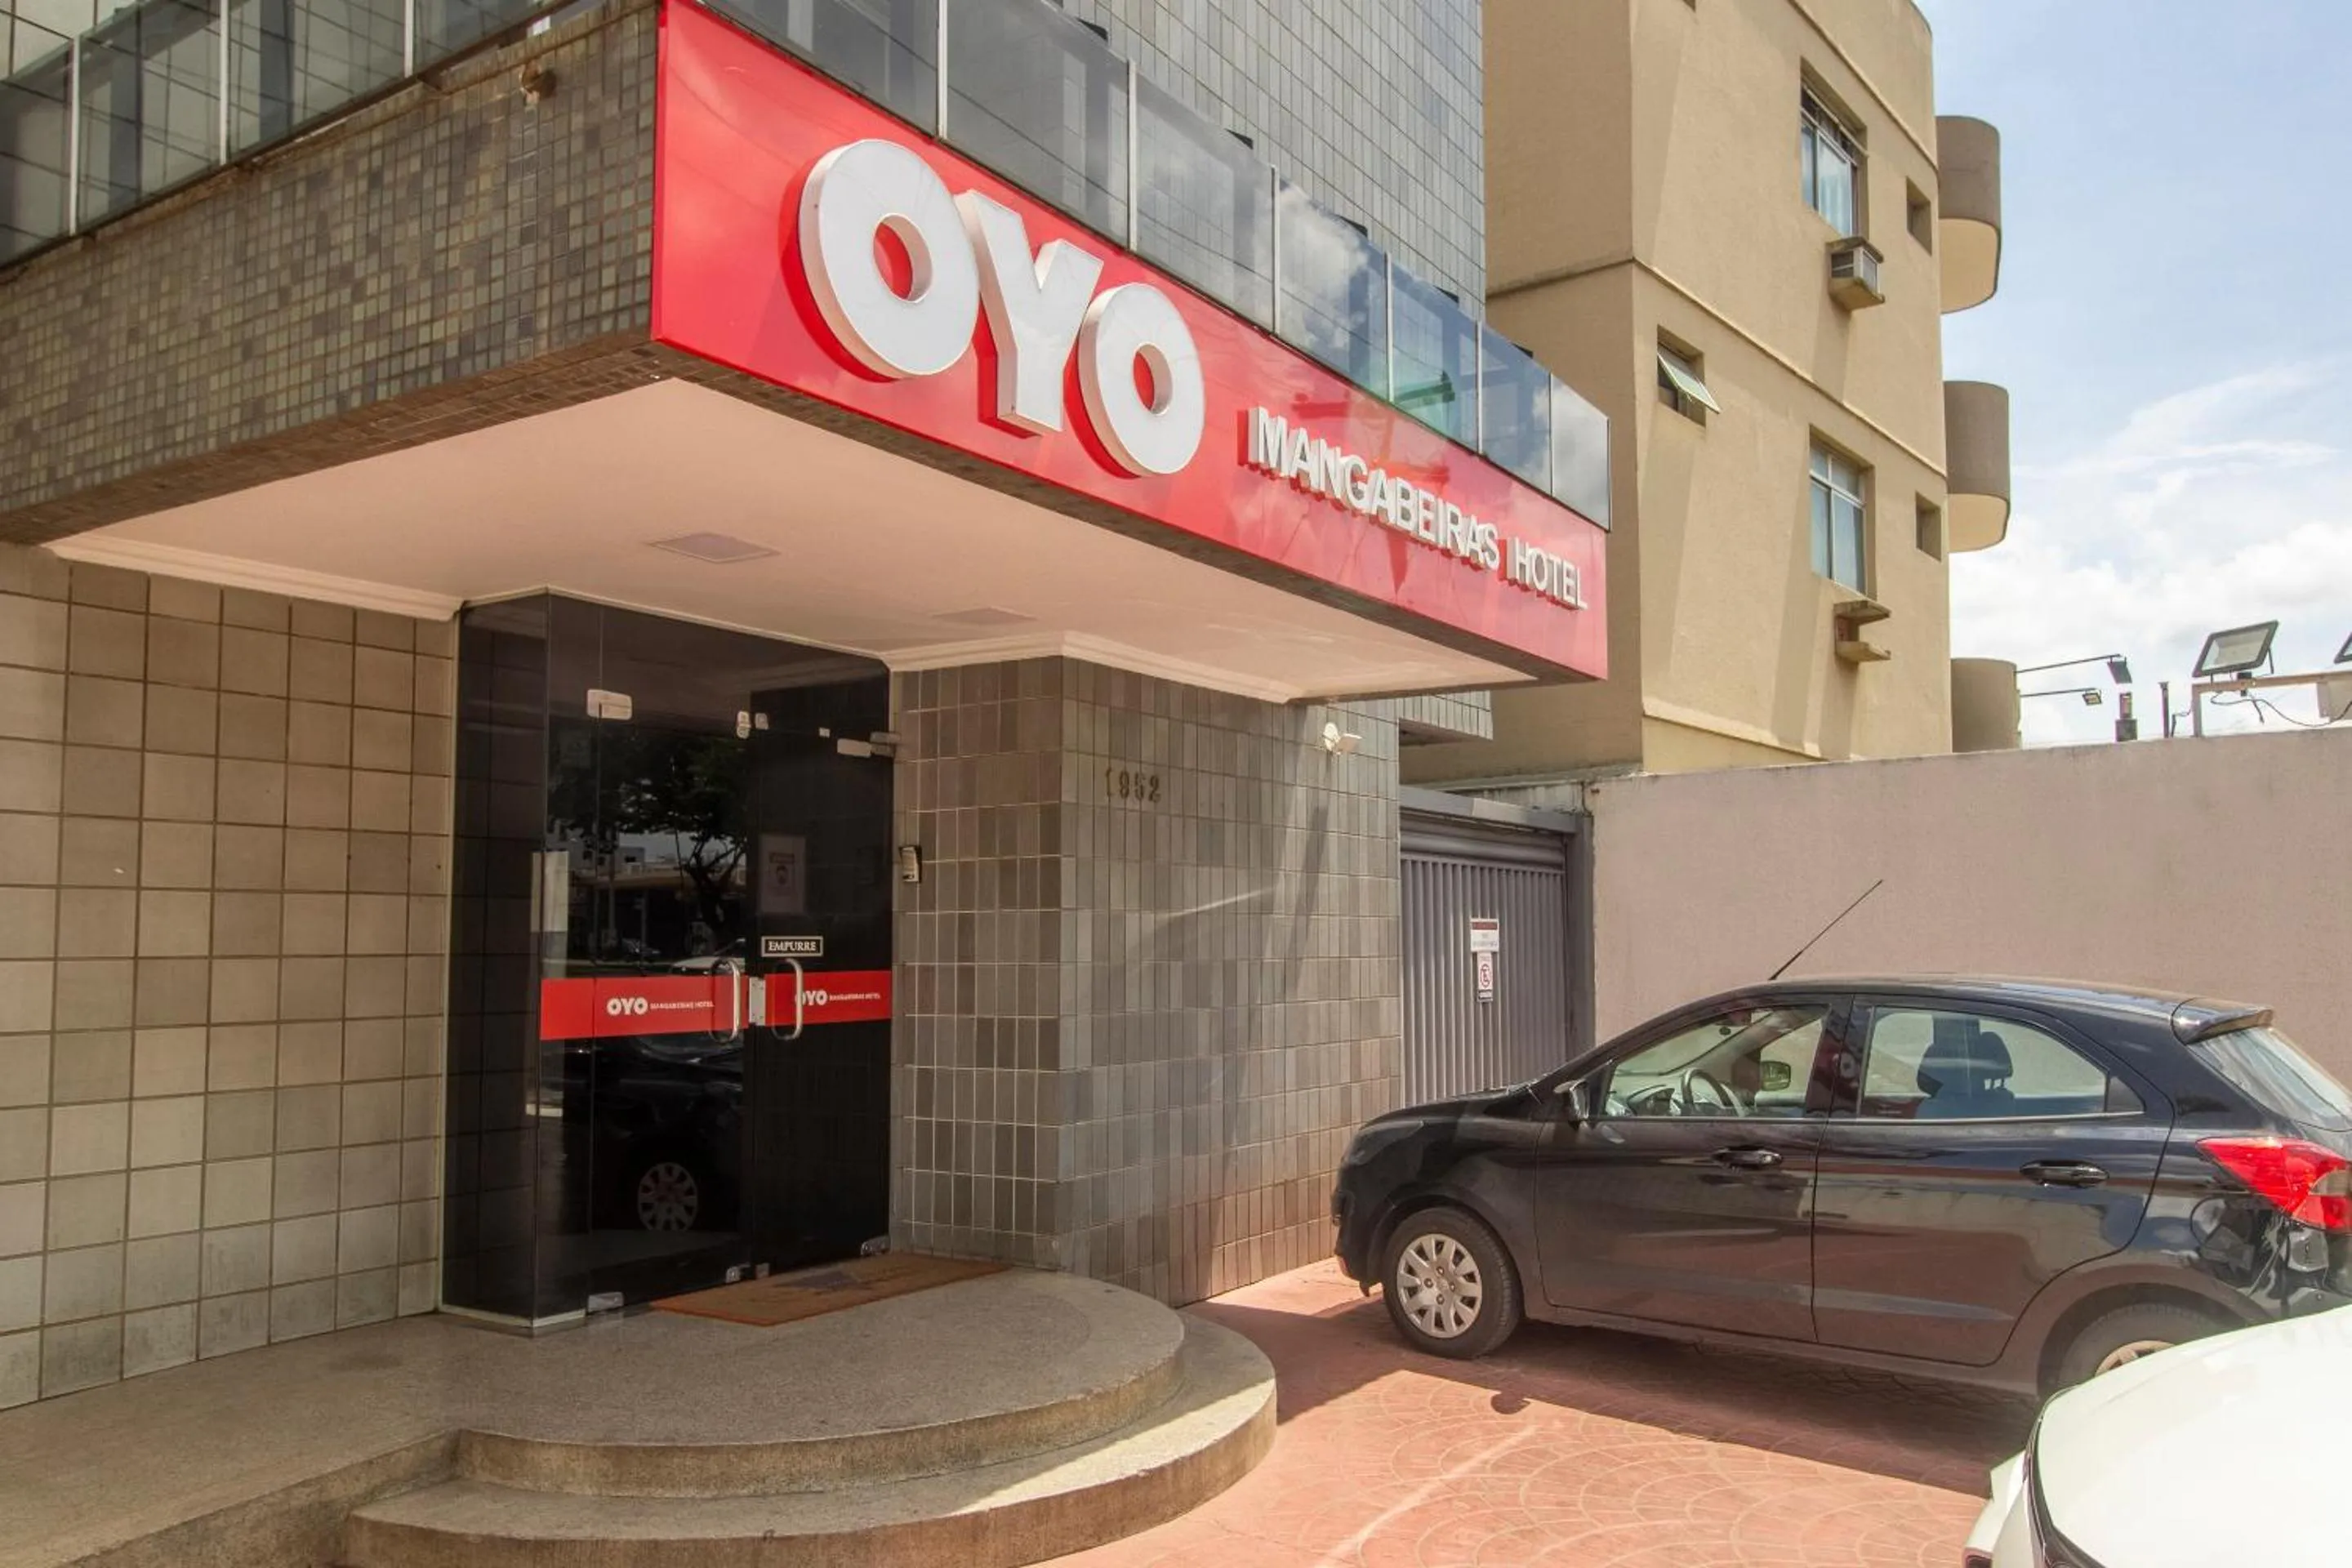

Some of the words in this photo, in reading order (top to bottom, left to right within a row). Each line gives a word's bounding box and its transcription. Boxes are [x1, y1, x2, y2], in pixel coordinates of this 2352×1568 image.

[799, 139, 1205, 476] OYO
[1249, 406, 1500, 571] MANGABEIRAS
[1507, 537, 1588, 611] HOTEL
[1106, 767, 1161, 803] 1852
[768, 940, 817, 951] EMPURRE
[607, 996, 648, 1015] OYO
